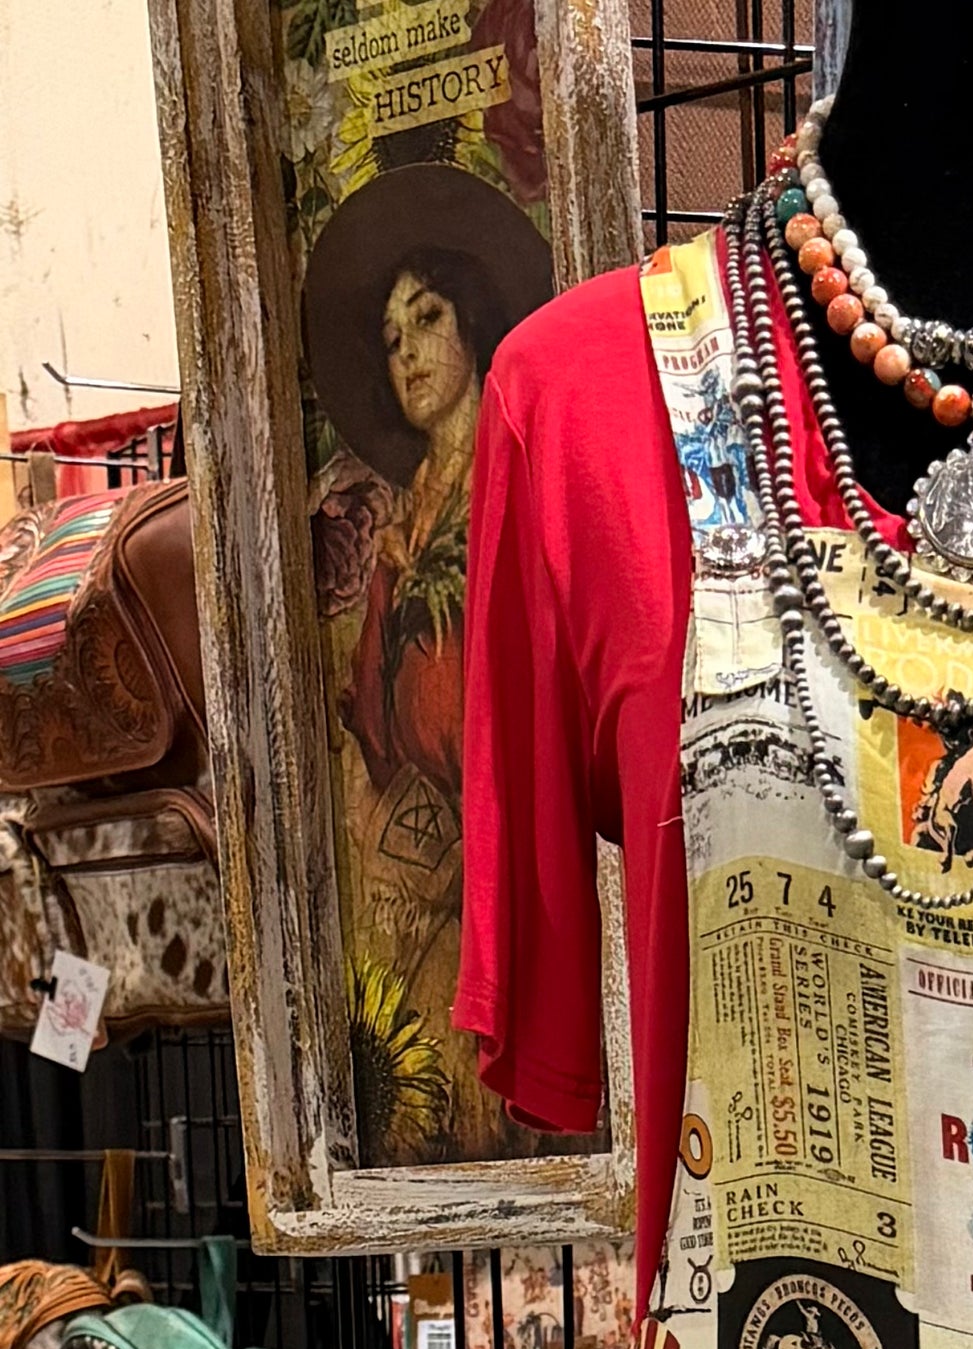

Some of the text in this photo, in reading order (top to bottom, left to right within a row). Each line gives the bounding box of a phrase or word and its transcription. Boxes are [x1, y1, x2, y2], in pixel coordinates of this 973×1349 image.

[333, 9, 461, 68] seldom make
[374, 55, 504, 123] HISTORY
[726, 871, 836, 917] 25 7 4
[916, 910, 955, 930] YOUR
[905, 920, 927, 936] BY
[795, 946, 812, 1030] SERIES
[806, 952, 833, 1163] WORLD'S 1919
[835, 1024, 851, 1104] CHICAGO
[860, 962, 897, 1183] AMERICAN LEAGUE
[771, 1094, 798, 1159] $5.50
[725, 1183, 779, 1206] RAIN
[726, 1200, 805, 1223] CHECK
[876, 1212, 897, 1238] 3
